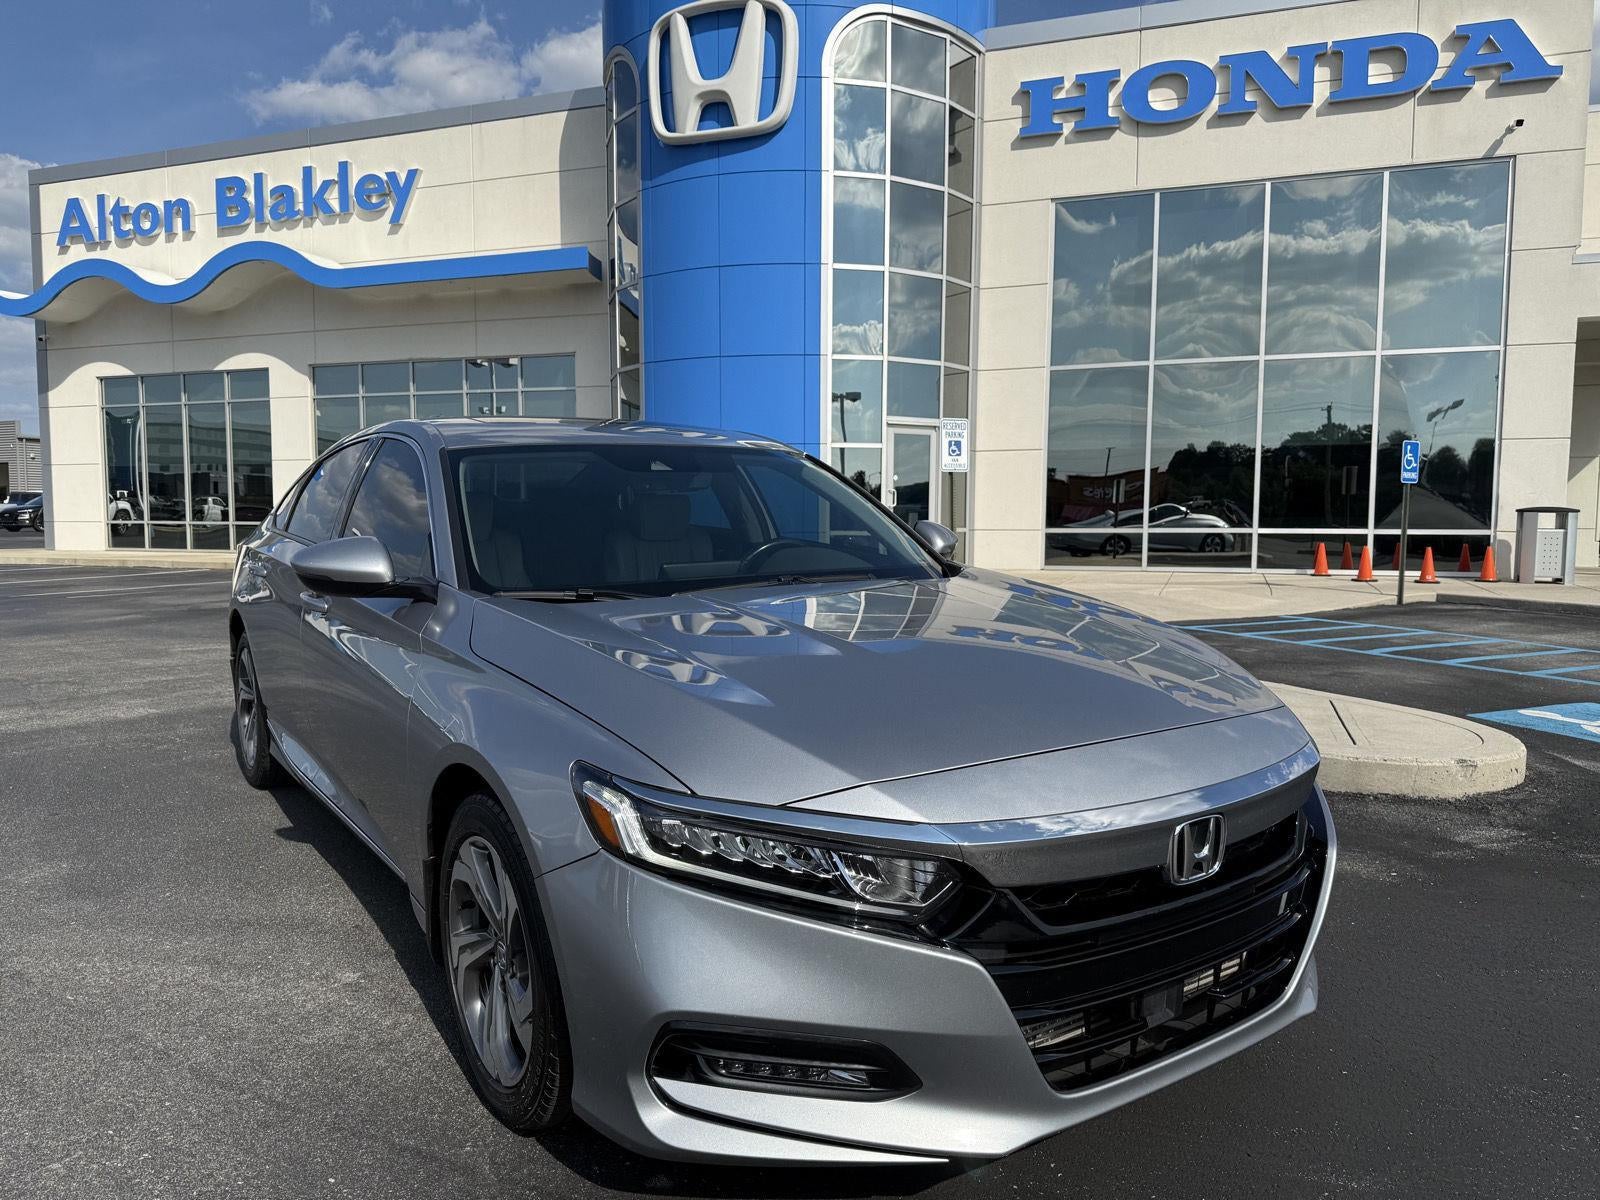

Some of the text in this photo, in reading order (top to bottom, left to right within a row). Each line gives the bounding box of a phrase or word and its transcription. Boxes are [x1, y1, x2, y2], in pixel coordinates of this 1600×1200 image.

[1018, 18, 1563, 138] HONDA
[56, 160, 420, 247] Alton Blakley
[942, 422, 967, 431] RESERVED
[945, 430, 965, 439] PARKING
